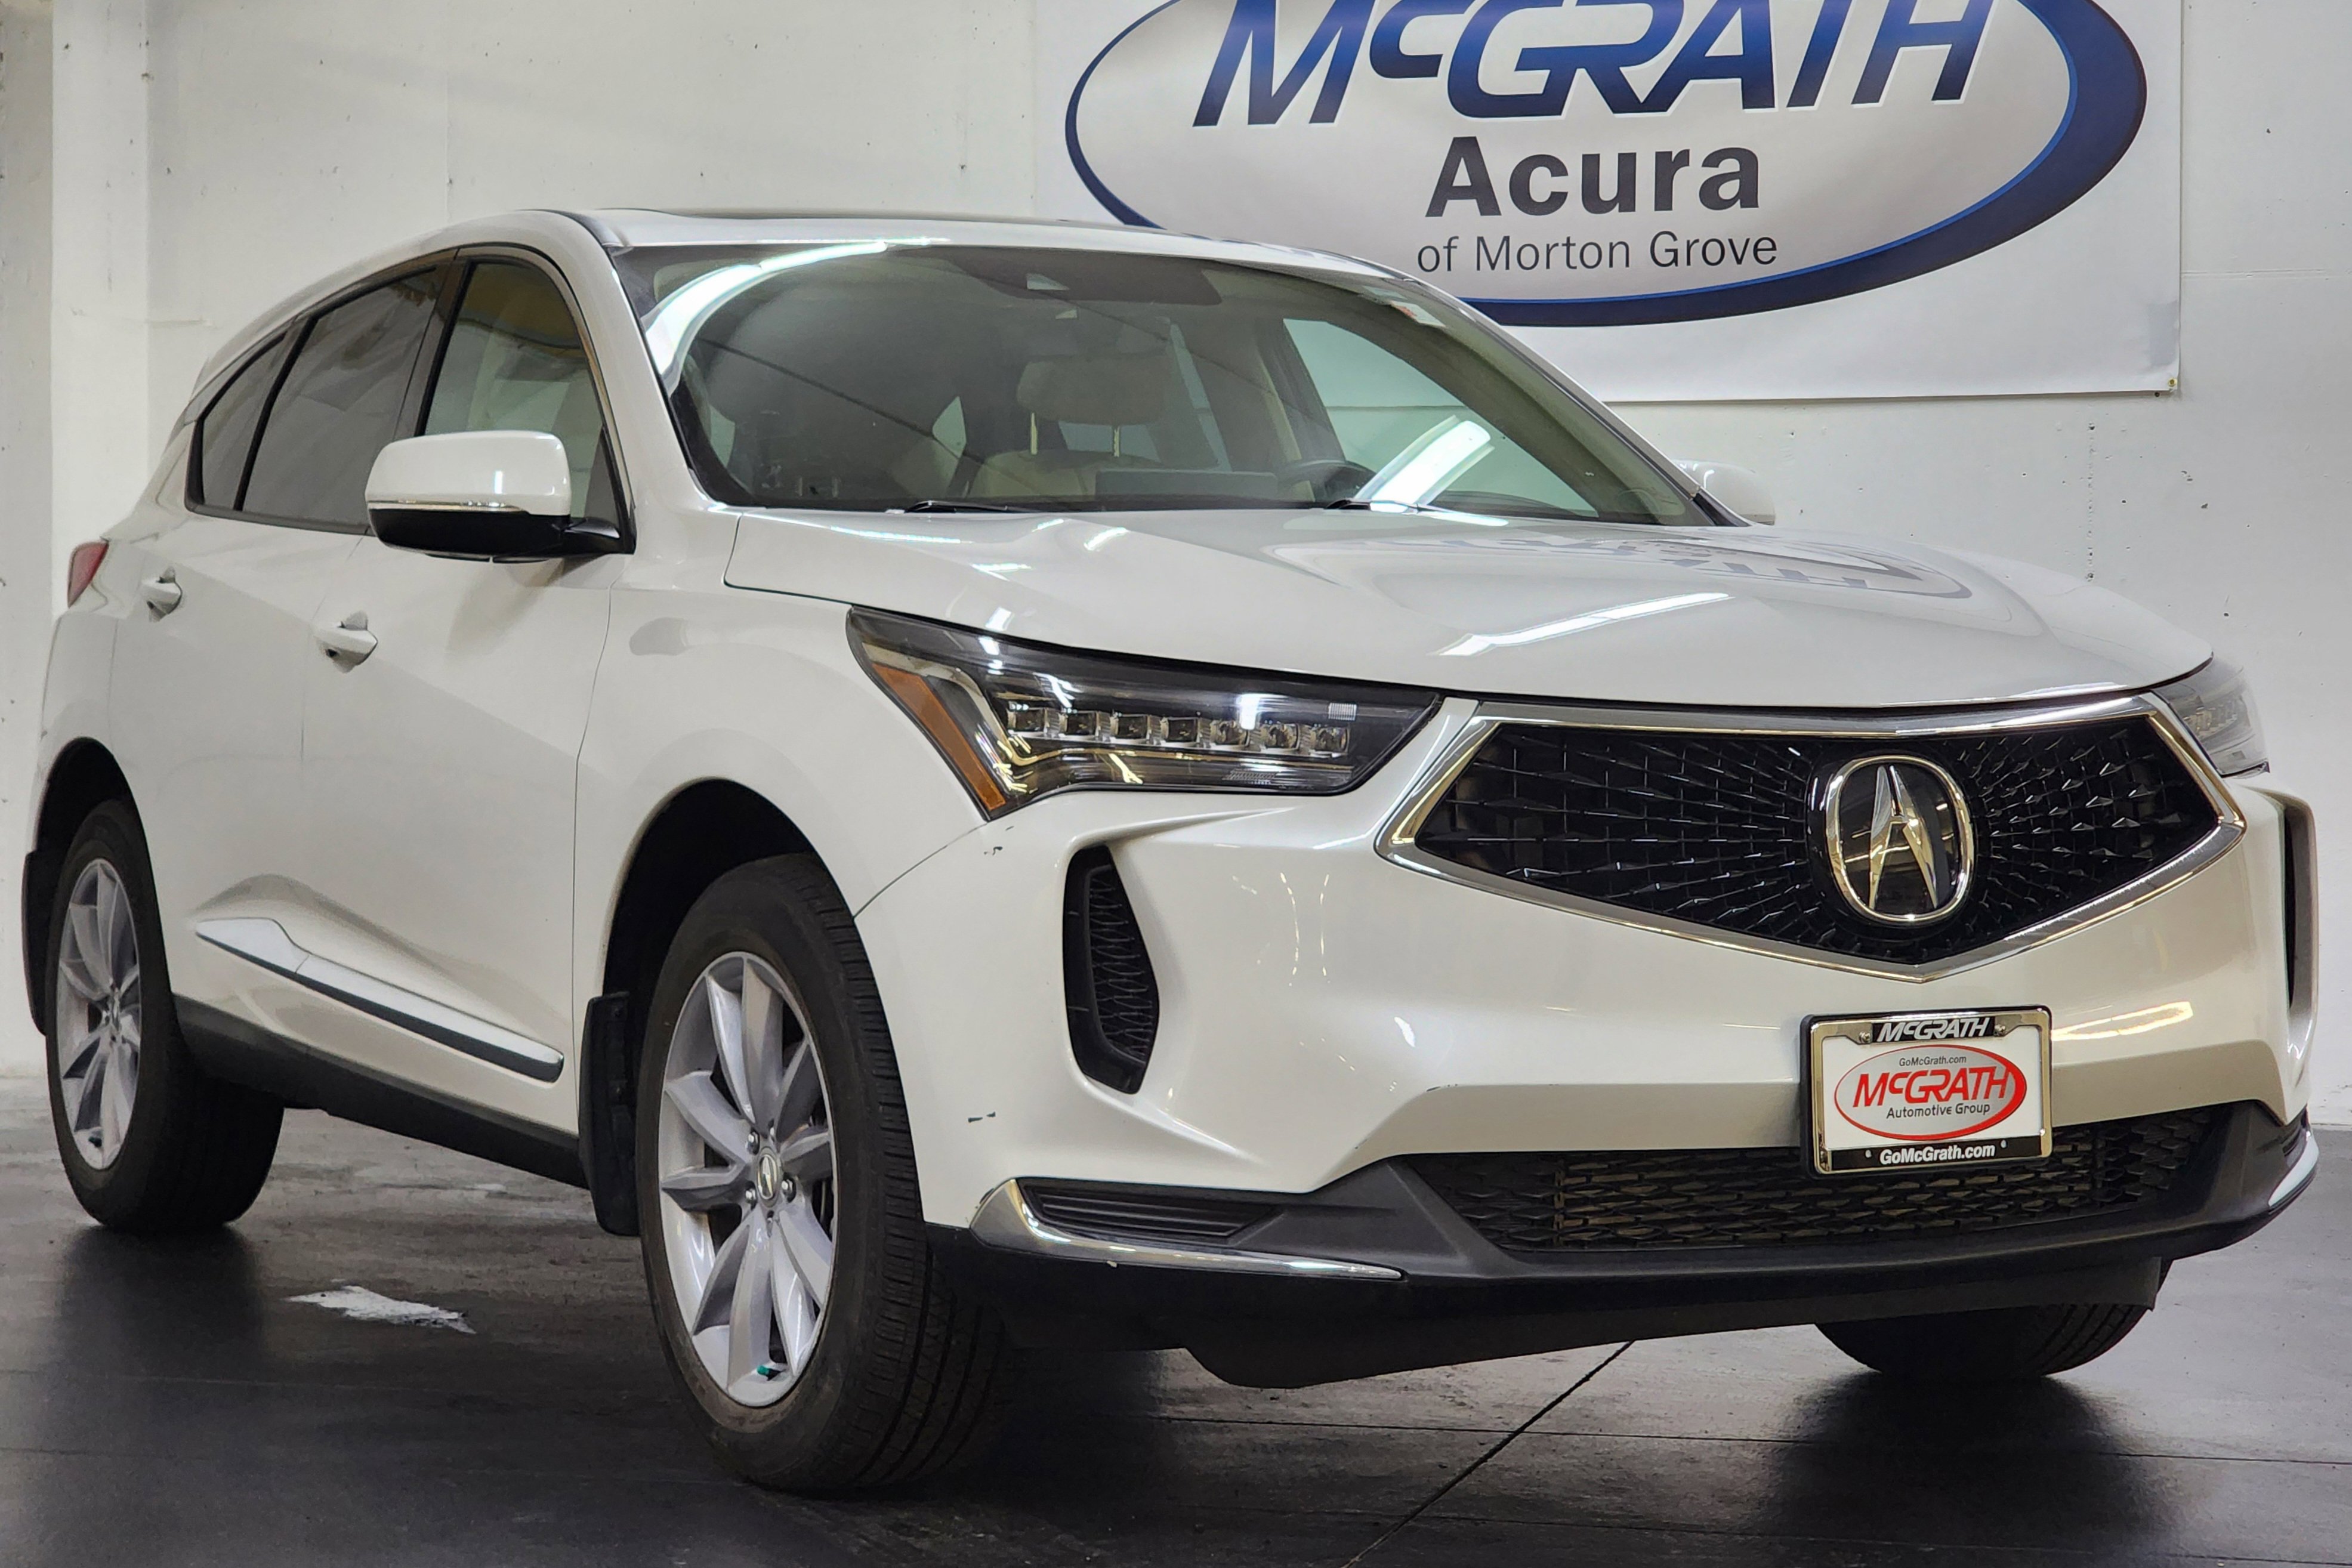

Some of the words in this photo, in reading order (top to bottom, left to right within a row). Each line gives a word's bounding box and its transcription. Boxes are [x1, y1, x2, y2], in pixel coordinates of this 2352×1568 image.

[1425, 135, 1759, 217] Acura
[1417, 236, 1459, 273] of
[1476, 235, 1631, 271] Morton
[1650, 230, 1777, 267] Grove
[1899, 1056, 1966, 1066] GoMcGrath.com
[1887, 1105, 1951, 1119] Automotive
[1956, 1103, 1990, 1115] Group
[1880, 1145, 1995, 1165] GoMcGrath.com
